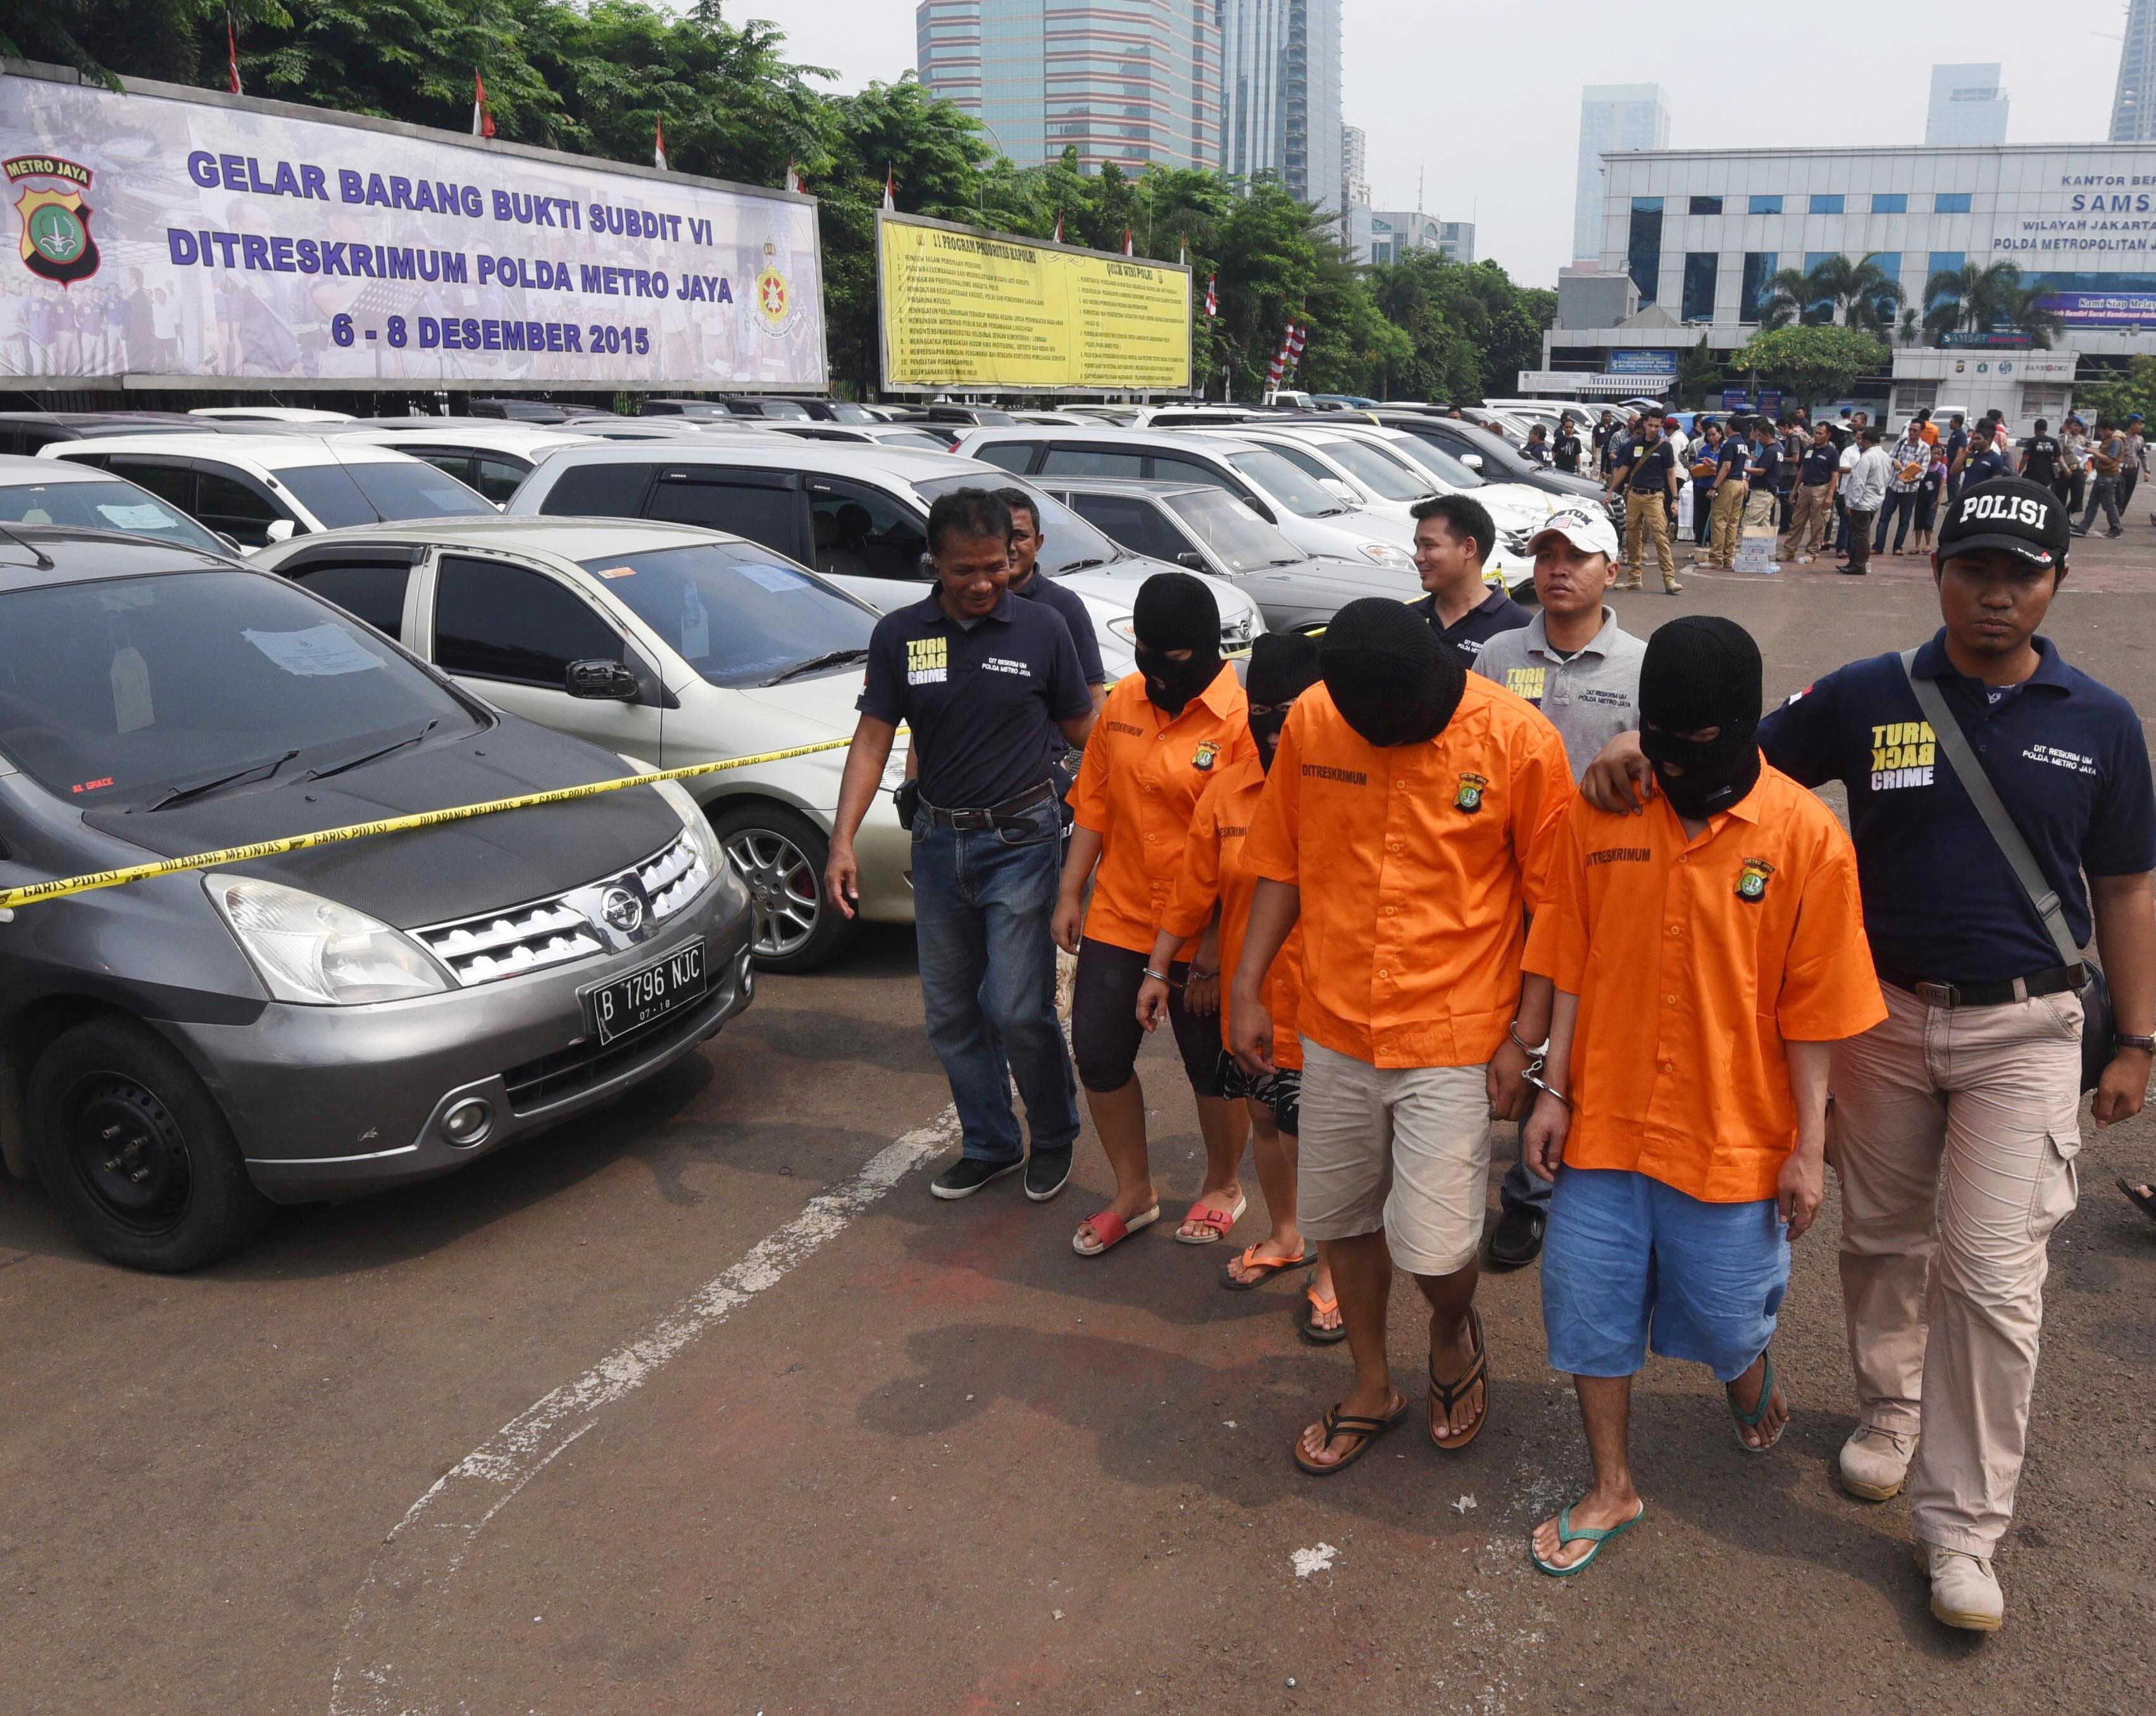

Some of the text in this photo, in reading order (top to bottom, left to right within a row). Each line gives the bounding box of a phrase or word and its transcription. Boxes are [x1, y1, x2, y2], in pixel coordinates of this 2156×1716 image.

[6, 159, 87, 183] METRO JAYA
[2062, 175, 2125, 185] KANTOR
[187, 151, 713, 246] GELAR BARANG BUKTI SUBDIT VI
[2071, 194, 2156, 211] SAMS
[2023, 220, 2086, 230] WILAYAH
[933, 233, 1036, 264] 11 PROGRAM PRIORITAS KAPOLRI
[1993, 238, 2037, 250] POLDA
[2041, 239, 2147, 249] METROPOLITAN
[167, 228, 733, 304] DITRESKRIMUM POLDA METRO JAYA
[2079, 298, 2104, 308] Kami
[2106, 299, 2128, 309] Siap
[332, 313, 355, 346] 6
[387, 315, 407, 348] 8
[418, 316, 583, 353] DESEMBER
[589, 325, 649, 355] 2015
[1959, 495, 2048, 530] POLISI
[906, 637, 947, 656] TURN
[1457, 643, 1470, 651] POLDA
[907, 668, 947, 685] CRIME
[982, 663, 1031, 677] POLDA METRO JAYA
[1507, 667, 1545, 683] TURN
[1578, 694, 1631, 708] POLDA METRO JAYA
[1872, 721, 1936, 748] TURN
[2022, 750, 2097, 776] POLDA METRO JAYA
[2033, 744, 2093, 765] DIT RESKRIM UM
[1302, 763, 1367, 786] DITRESKRIMUM
[1871, 766, 1933, 791] CRIME
[23, 881, 67, 897] GARIS
[160, 853, 221, 871] DILARANG
[225, 841, 282, 861] MELINTAS
[314, 830, 347, 845] GARIS
[352, 823, 387, 838] POLISI
[420, 809, 467, 826] DILARANG
[470, 802, 514, 816] MELINTAS
[1586, 848, 1651, 867] DITRESKRIMUM
[602, 949, 699, 1021] B 1796 NJC
